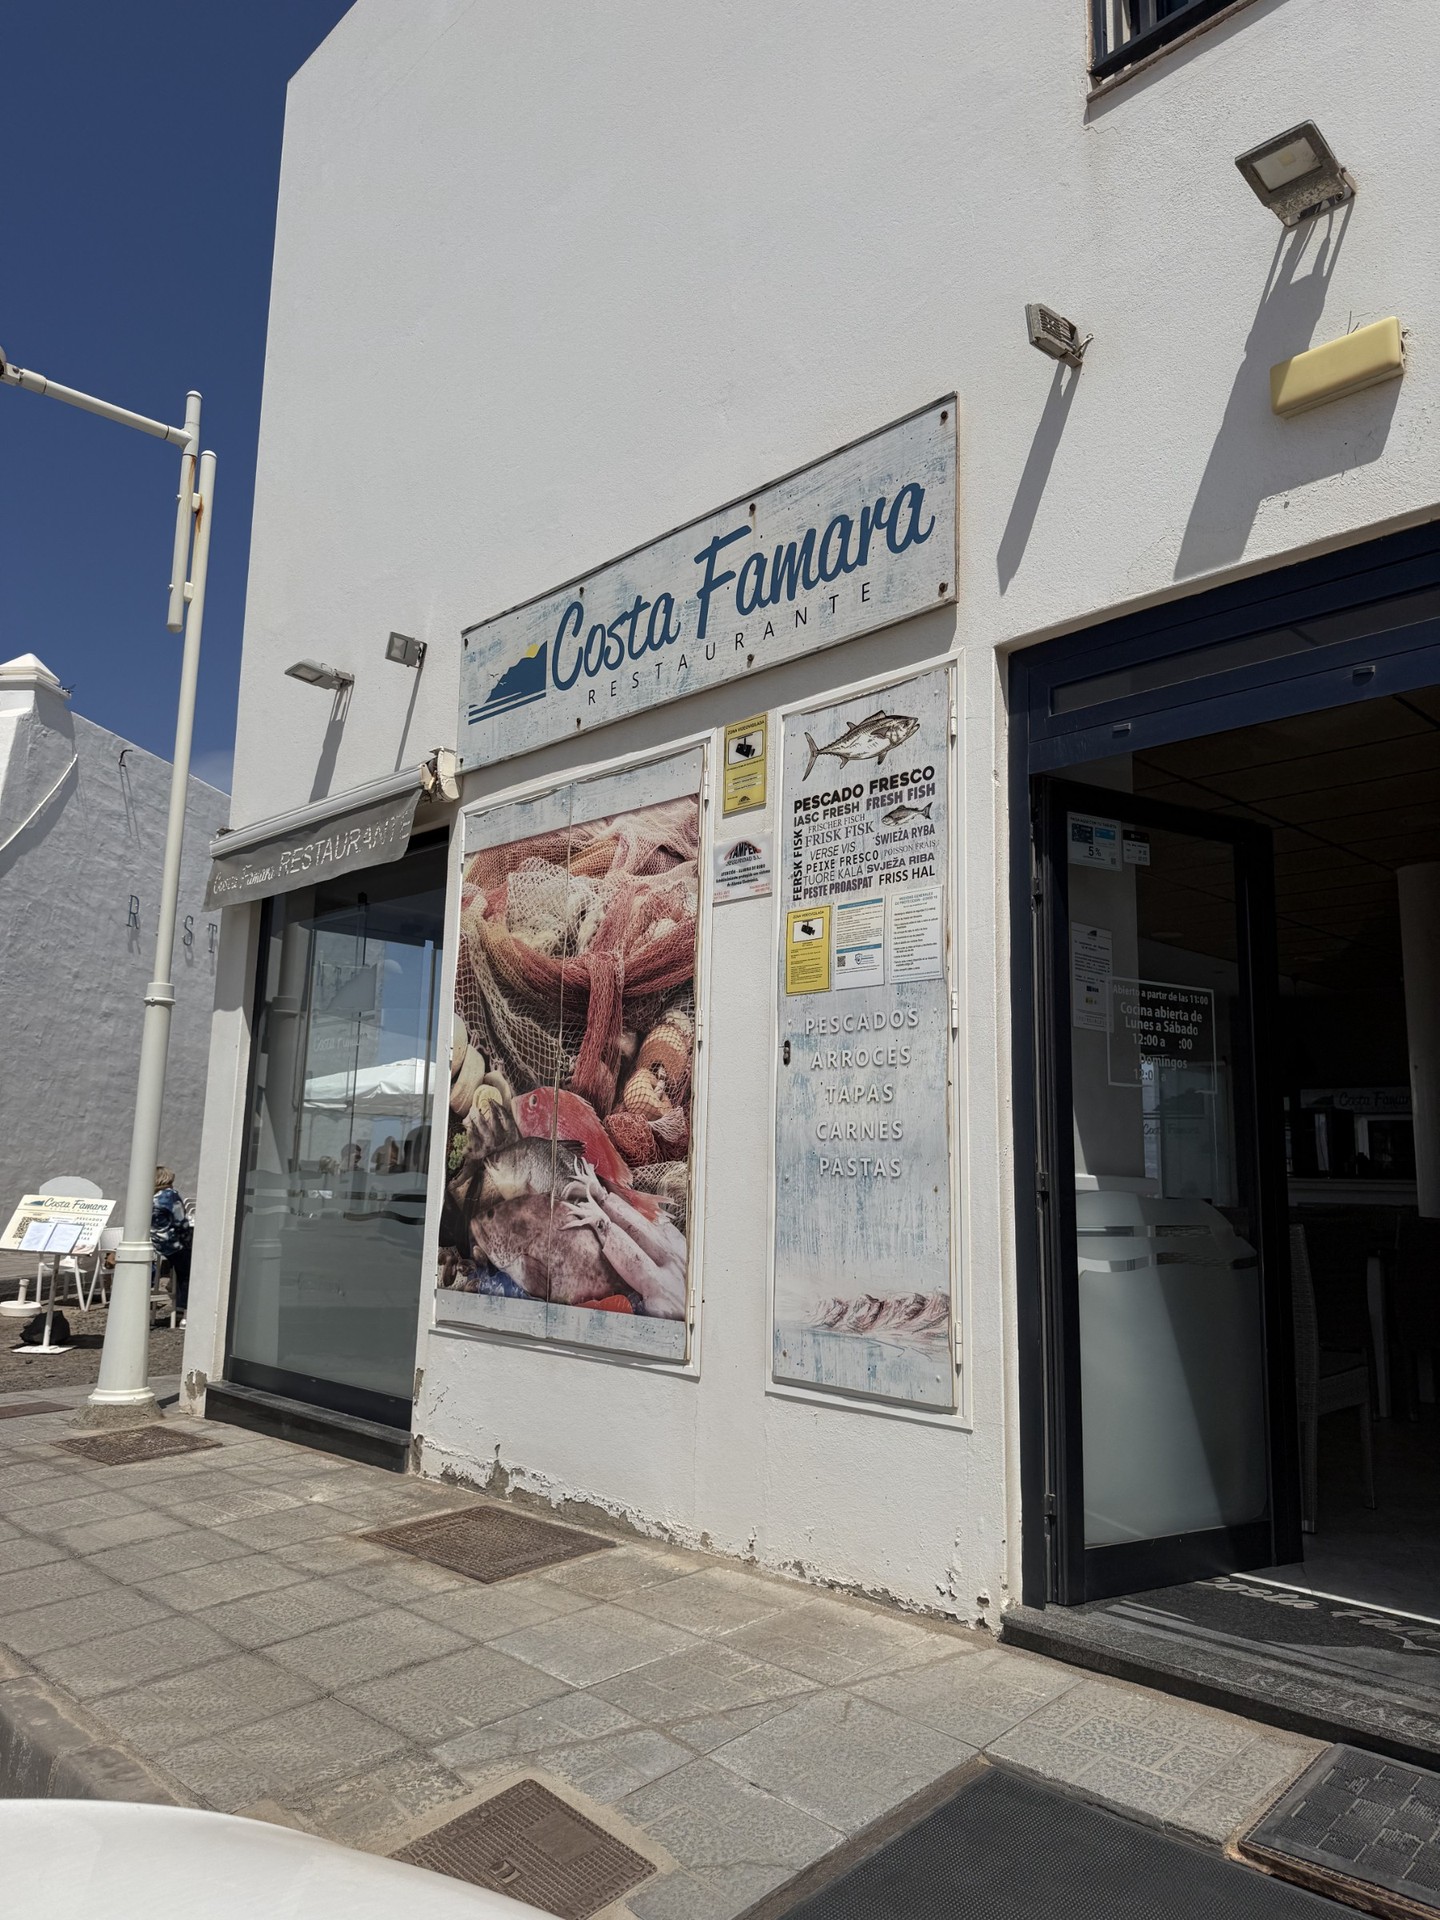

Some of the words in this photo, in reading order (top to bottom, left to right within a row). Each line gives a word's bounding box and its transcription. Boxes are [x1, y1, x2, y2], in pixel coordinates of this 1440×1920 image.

[551, 601, 682, 692] Costa
[693, 482, 936, 640] Famara
[587, 581, 871, 705] RESTAURANTE
[794, 784, 864, 814] PESCADO
[869, 765, 935, 795] FRESCO
[866, 790, 903, 811] FRESH
[907, 782, 936, 801] FISH
[794, 812, 819, 827] IASC
[823, 801, 860, 820] FRESH
[808, 818, 842, 834] FRISCHER
[843, 813, 865, 826] FISCH
[805, 828, 842, 848] FRISK
[845, 820, 875, 839] FISK
[911, 823, 936, 839] RYBA
[278, 809, 412, 877] RESTAURANTE
[792, 829, 803, 859] FISK
[810, 845, 839, 861] VERSE
[841, 841, 856, 854] VIS
[806, 859, 835, 874] PEIXE
[840, 850, 879, 868] FRESCO
[866, 857, 906, 874] SVJEŽA
[909, 852, 935, 865] RIBA
[792, 860, 803, 902] FERSK
[803, 871, 835, 887] TUORE
[838, 866, 864, 880] KALA
[879, 870, 909, 886] FRISS
[912, 865, 936, 880] HAL
[803, 884, 828, 900] PESTE
[829, 876, 874, 897] PROASPAT
[126, 894, 218, 954] RST
[1113, 985, 1140, 998] Abierto
[1147, 991, 1167, 1002] partir
[1168, 992, 1178, 1002] de
[1179, 993, 1189, 1004] las
[1190, 994, 1208, 1005] 11:00
[805, 1007, 920, 1035] PESCADOS
[1120, 1002, 1153, 1017] Cocina
[1155, 1005, 1189, 1022] abierta
[1191, 1008, 1203, 1023] de
[1125, 1015, 1154, 1031] Lunes
[1156, 1022, 1162, 1031] a
[1163, 1019, 1199, 1036] Sábado
[1132, 1033, 1158, 1047] 12:00
[1160, 1037, 1166, 1047] a
[811, 1045, 912, 1070] ARROCES
[1139, 1053, 1188, 1071] Domingos
[826, 1083, 894, 1104] TAPAS
[816, 1120, 903, 1141] CARNES
[819, 1156, 902, 1178] PASTAS
[44, 1197, 71, 1208] Costa
[72, 1199, 108, 1211] Famara
